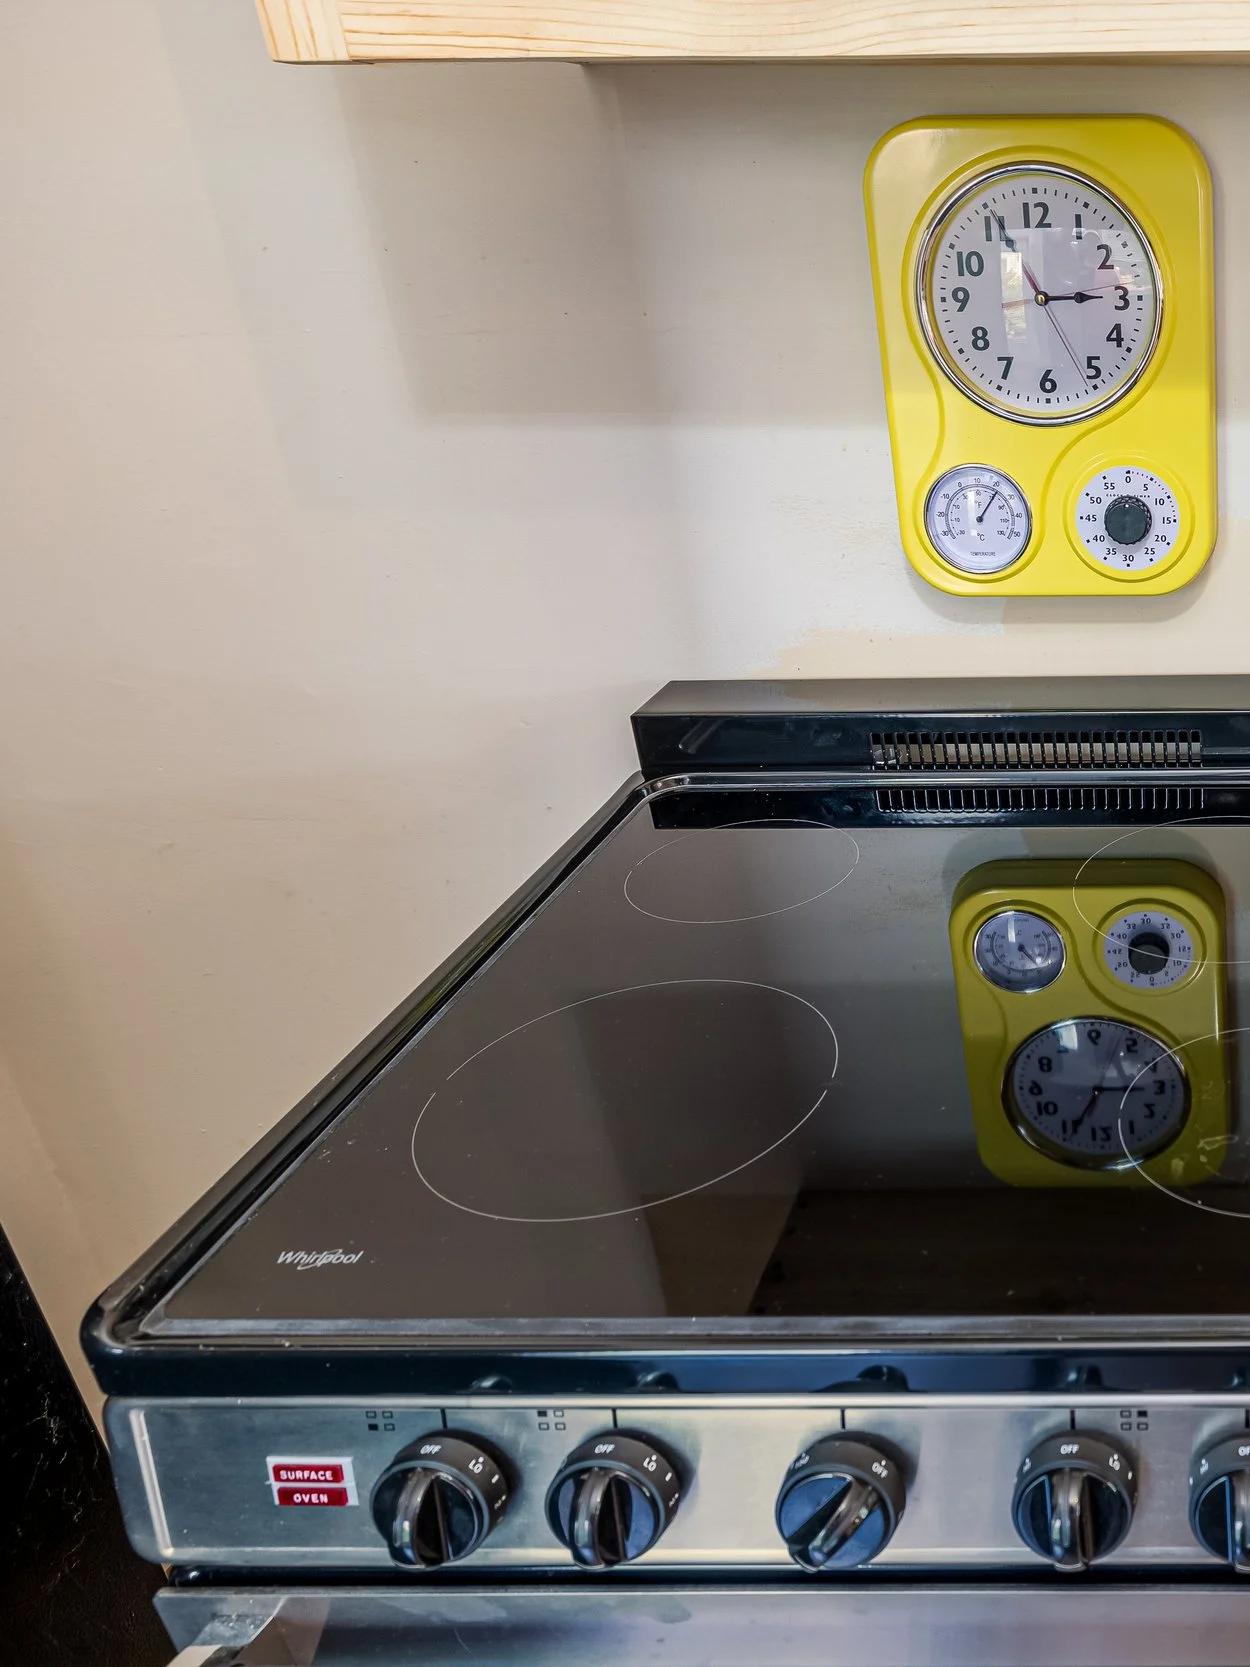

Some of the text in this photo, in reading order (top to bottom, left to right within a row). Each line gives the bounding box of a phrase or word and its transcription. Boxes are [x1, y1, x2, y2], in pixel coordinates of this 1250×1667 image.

[1022, 202, 1052, 228] 12
[984, 215, 1005, 242] 11
[1075, 214, 1083, 240] 1
[957, 251, 984, 277] 10
[1097, 244, 1115, 270] 2
[952, 287, 970, 312] 9
[1114, 286, 1130, 310] 3
[971, 326, 990, 351] 8
[1106, 324, 1124, 348] 4
[997, 356, 1014, 380] 7
[1086, 356, 1102, 380] 5
[1039, 369, 1057, 393] 6
[1155, 498, 1165, 506] 10
[1145, 547, 1155, 555] 25
[277, 1249, 364, 1270] Whirlpool
[420, 1445, 442, 1454] OFF
[595, 1444, 615, 1454] OFF
[1060, 1444, 1080, 1454] OFF
[468, 1459, 483, 1474] LO
[643, 1457, 657, 1472] LO
[872, 1462, 888, 1478] OFF
[1109, 1456, 1120, 1471] LO
[280, 1470, 333, 1481] SURFACE
[293, 1493, 328, 1504] OVEN
